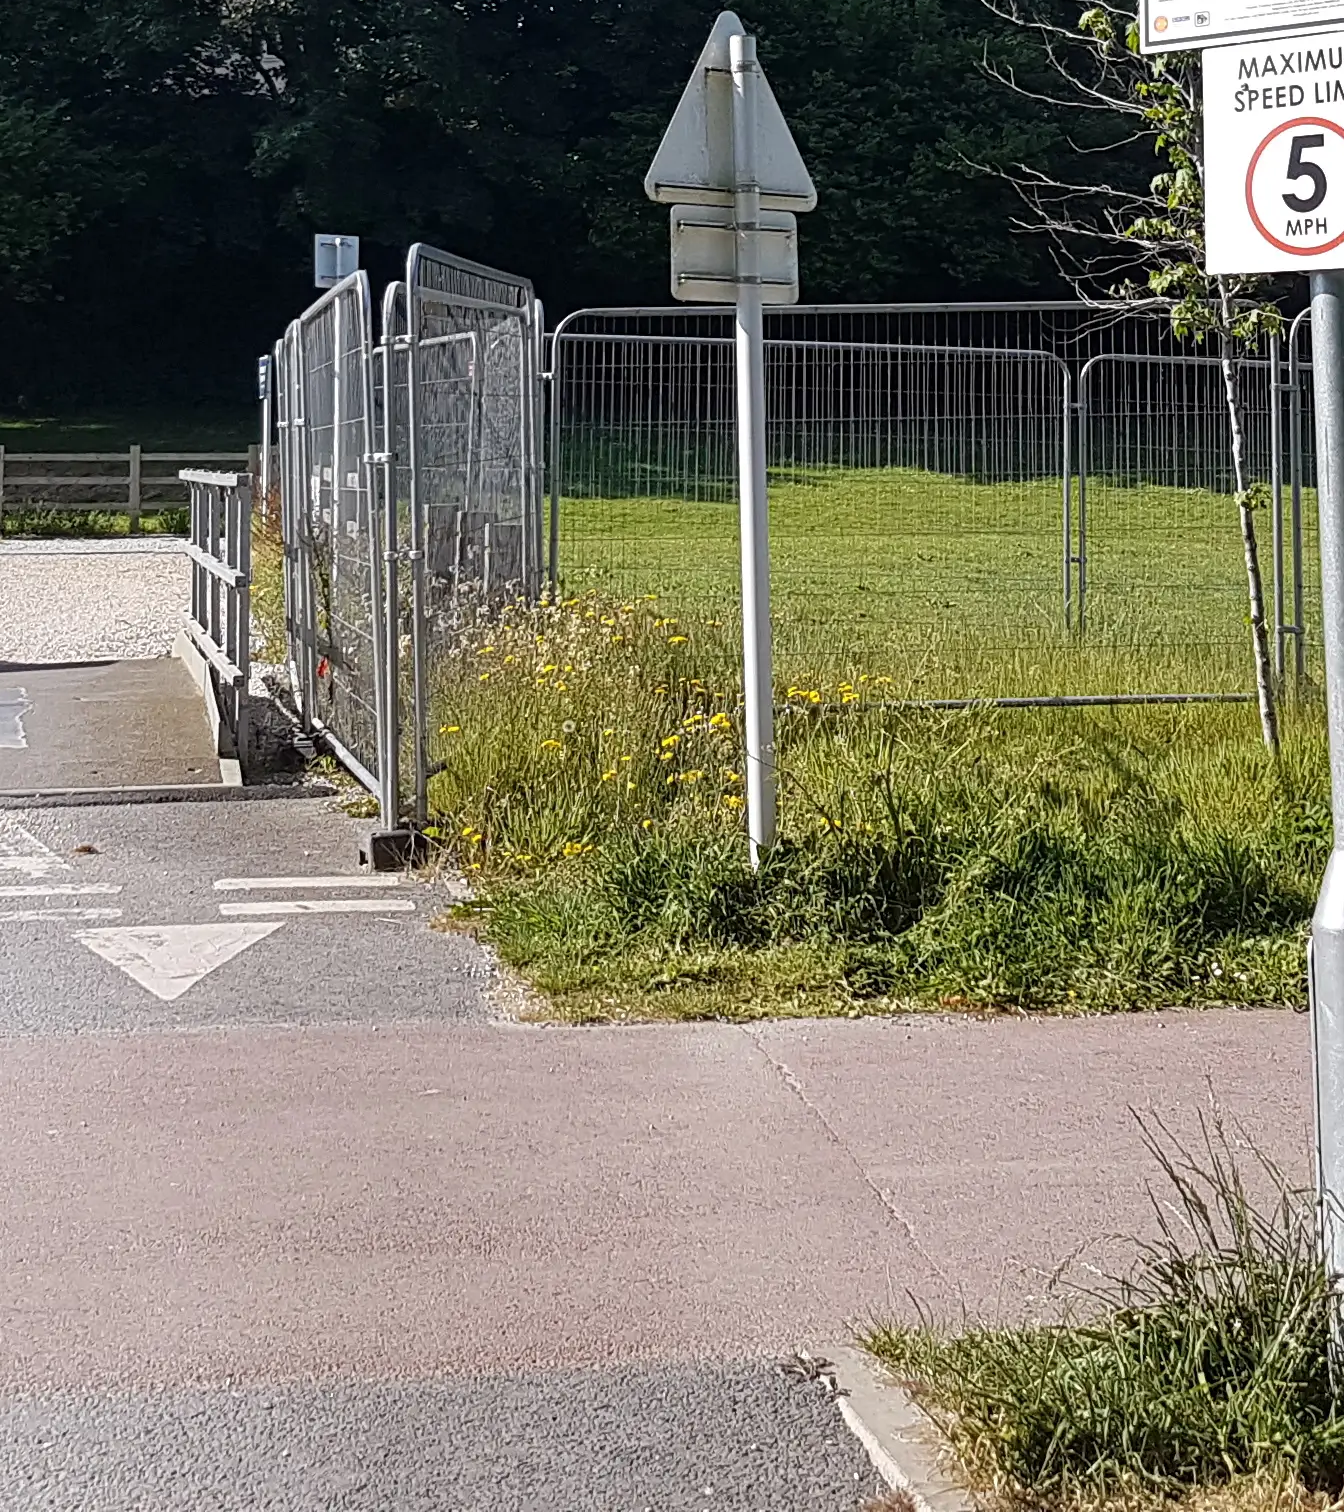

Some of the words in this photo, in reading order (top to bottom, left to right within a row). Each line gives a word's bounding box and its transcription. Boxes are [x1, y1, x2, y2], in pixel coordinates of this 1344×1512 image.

[1234, 85, 1305, 113] SPEED
[1282, 133, 1328, 213] 5
[1286, 217, 1328, 237] MPH
